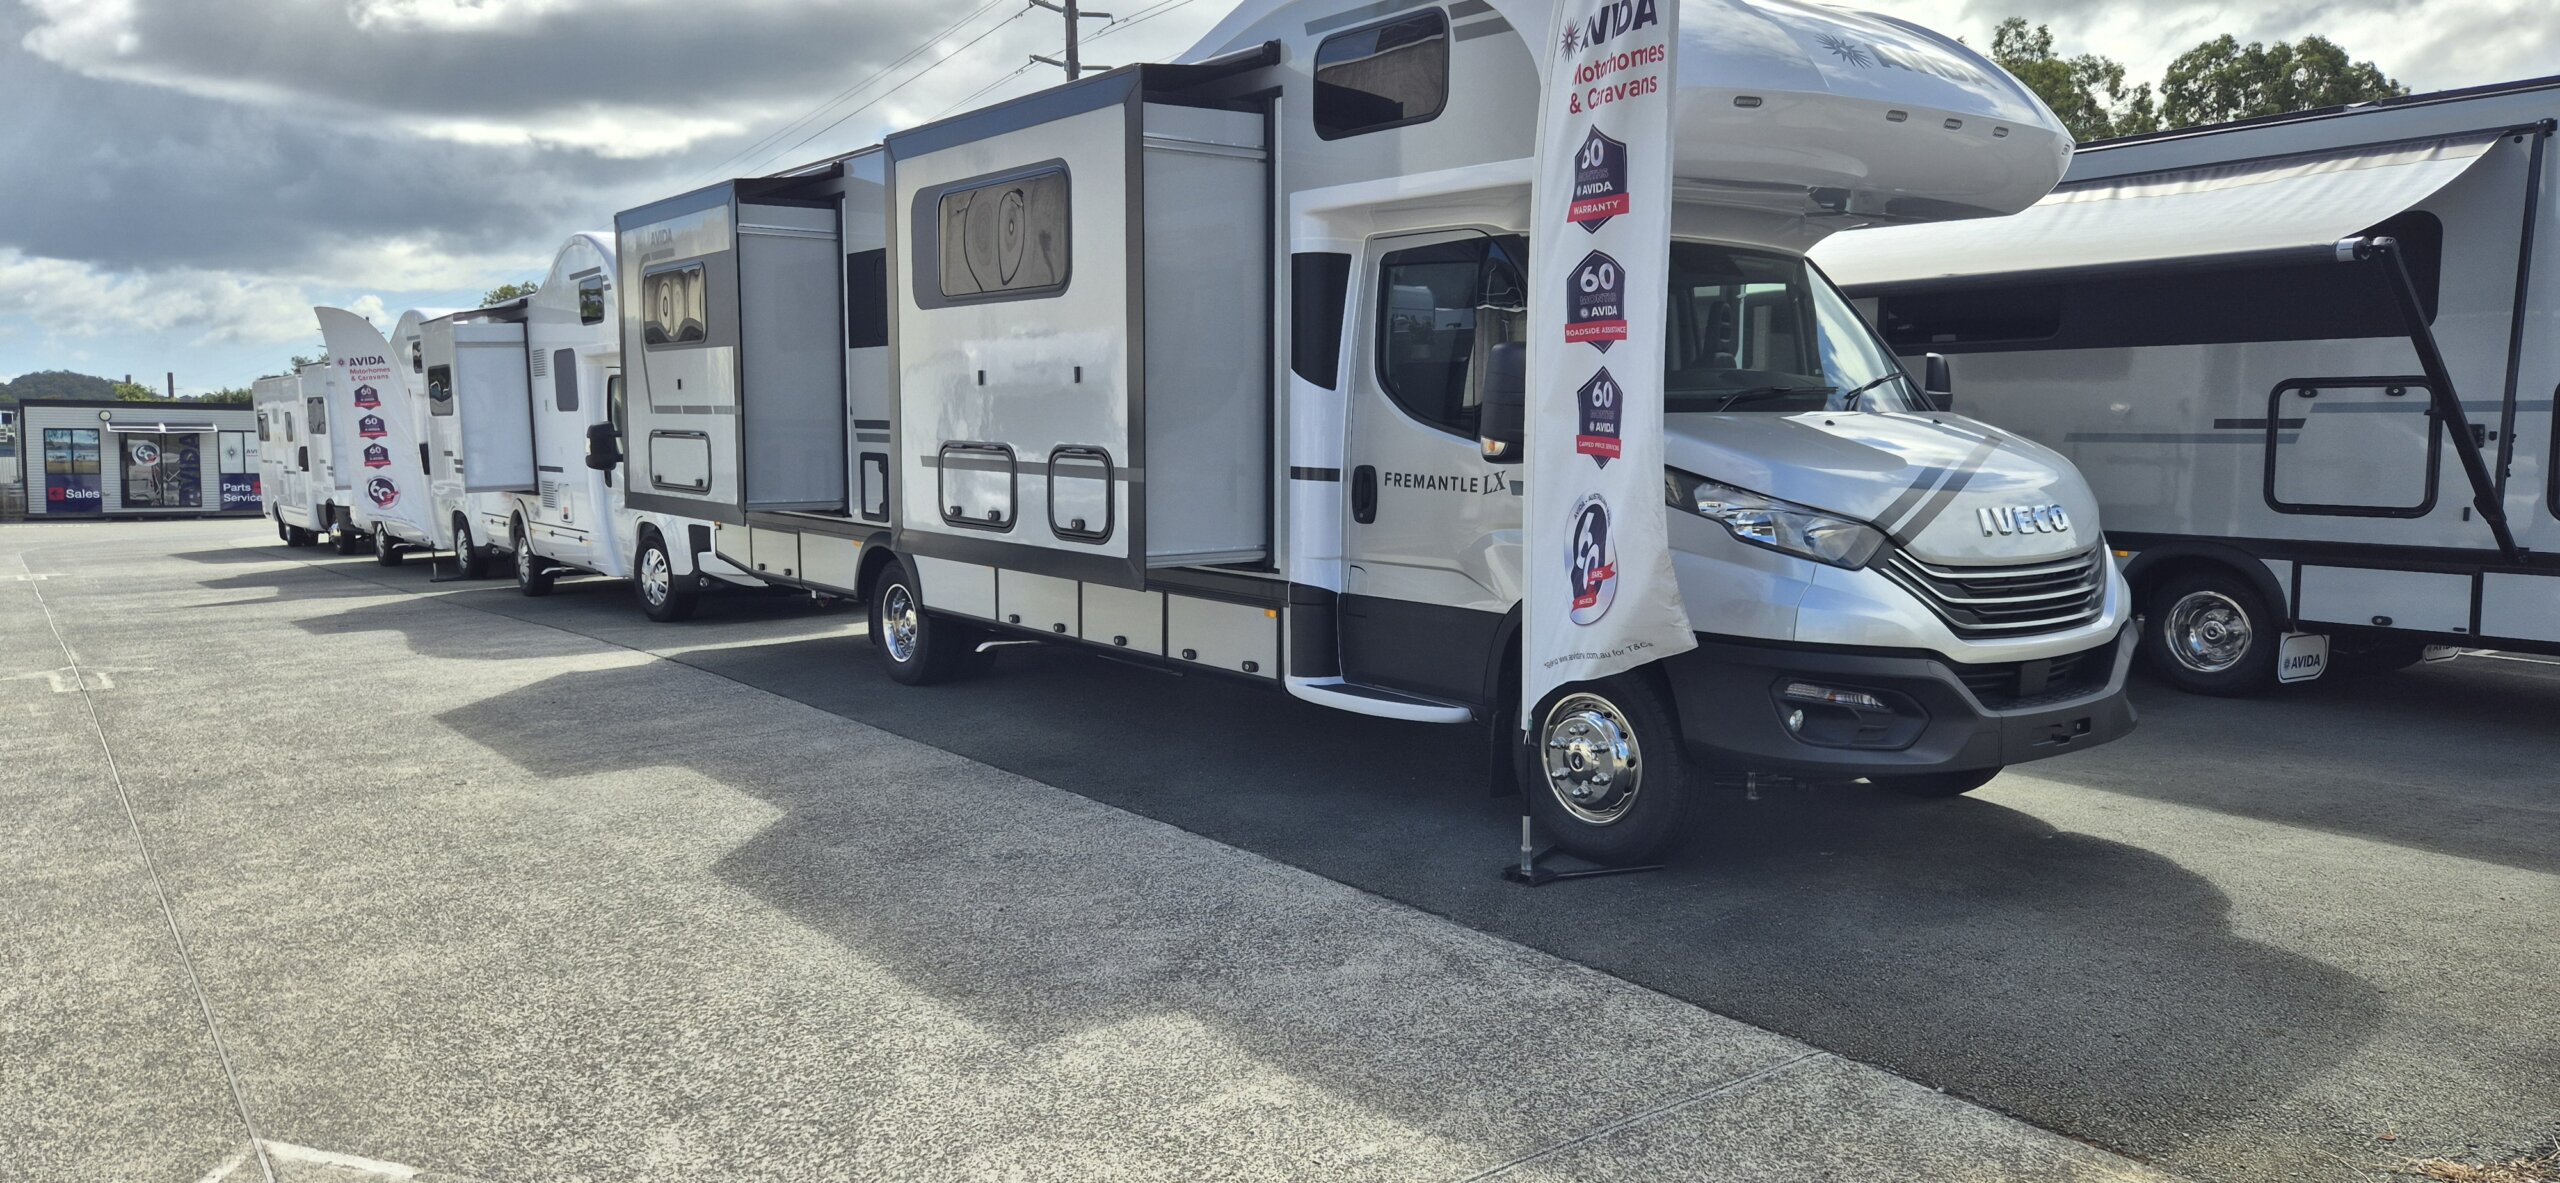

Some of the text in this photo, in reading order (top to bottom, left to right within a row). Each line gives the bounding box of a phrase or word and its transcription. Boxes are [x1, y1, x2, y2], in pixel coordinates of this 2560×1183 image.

[1572, 43, 1665, 86] Motorhomes
[1569, 75, 1657, 115] & Caravans
[1581, 138, 1604, 169] 60
[1582, 181, 1613, 196] AVIDA
[651, 228, 673, 248] AVIDA
[1580, 263, 1615, 293] 60
[1591, 305, 1618, 317] AVIDA
[1566, 326, 1600, 337] ROADSIDE
[349, 356, 385, 367] AVIDA
[1592, 381, 1613, 408] 60
[1596, 422, 1614, 433] AVIDA
[223, 483, 251, 492] Parts
[1384, 470, 1506, 495] FREMANTLE LX
[66, 488, 100, 499] Sales
[1976, 504, 2069, 537] IVECO
[2291, 654, 2320, 669] AVIDA
